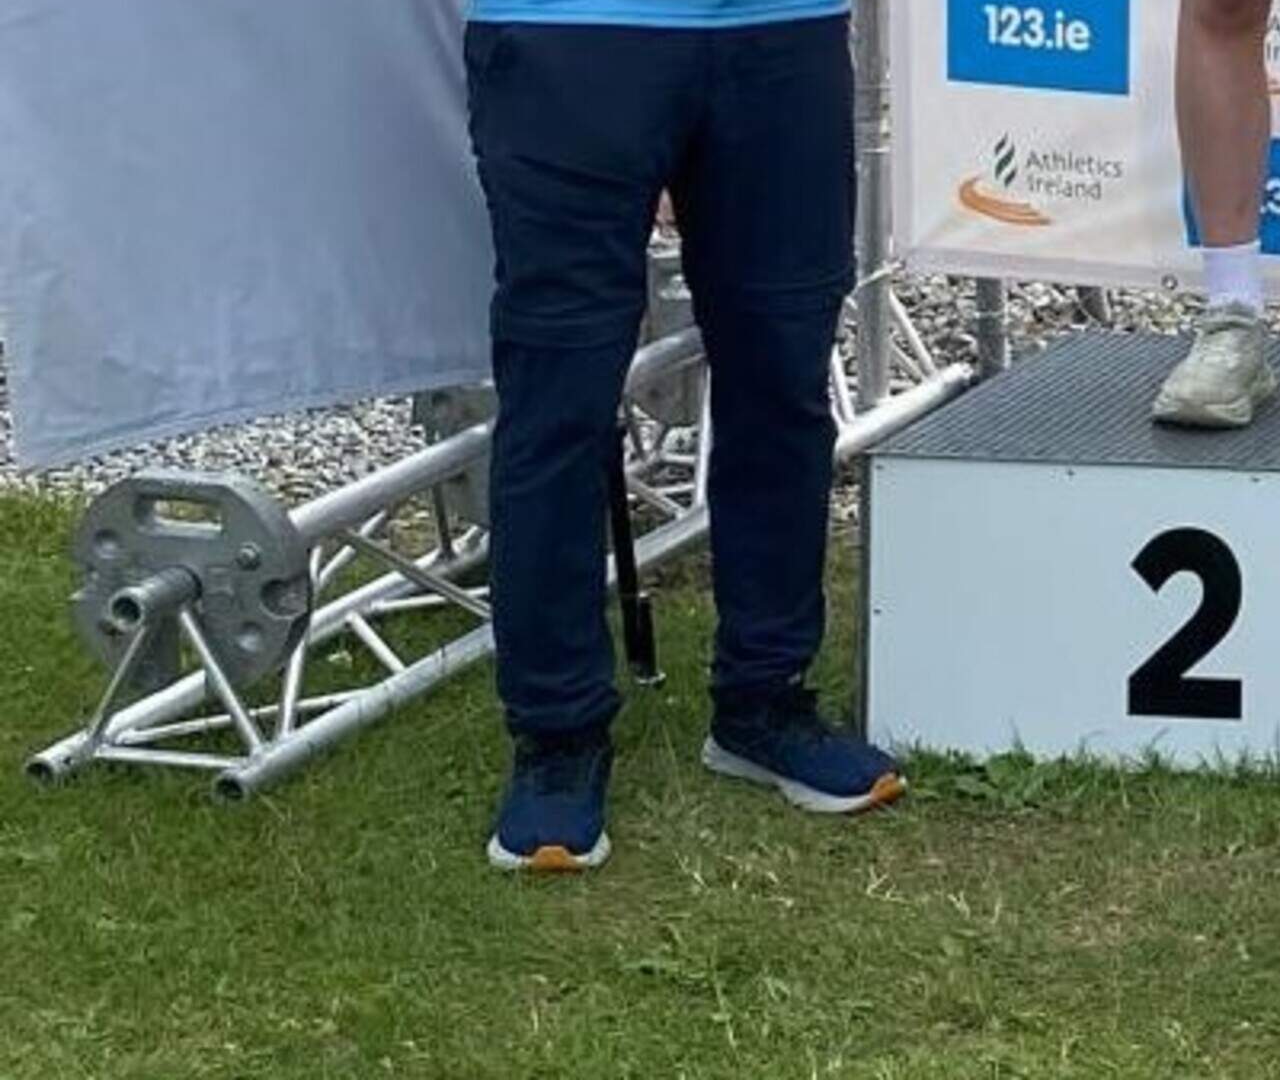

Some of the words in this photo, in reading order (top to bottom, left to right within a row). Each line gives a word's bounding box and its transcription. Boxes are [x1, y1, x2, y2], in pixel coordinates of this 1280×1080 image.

[984, 5, 1091, 51] 123.ie
[1026, 150, 1123, 179] Athletics
[1026, 176, 1102, 200] Ireland
[1127, 525, 1243, 720] 2
